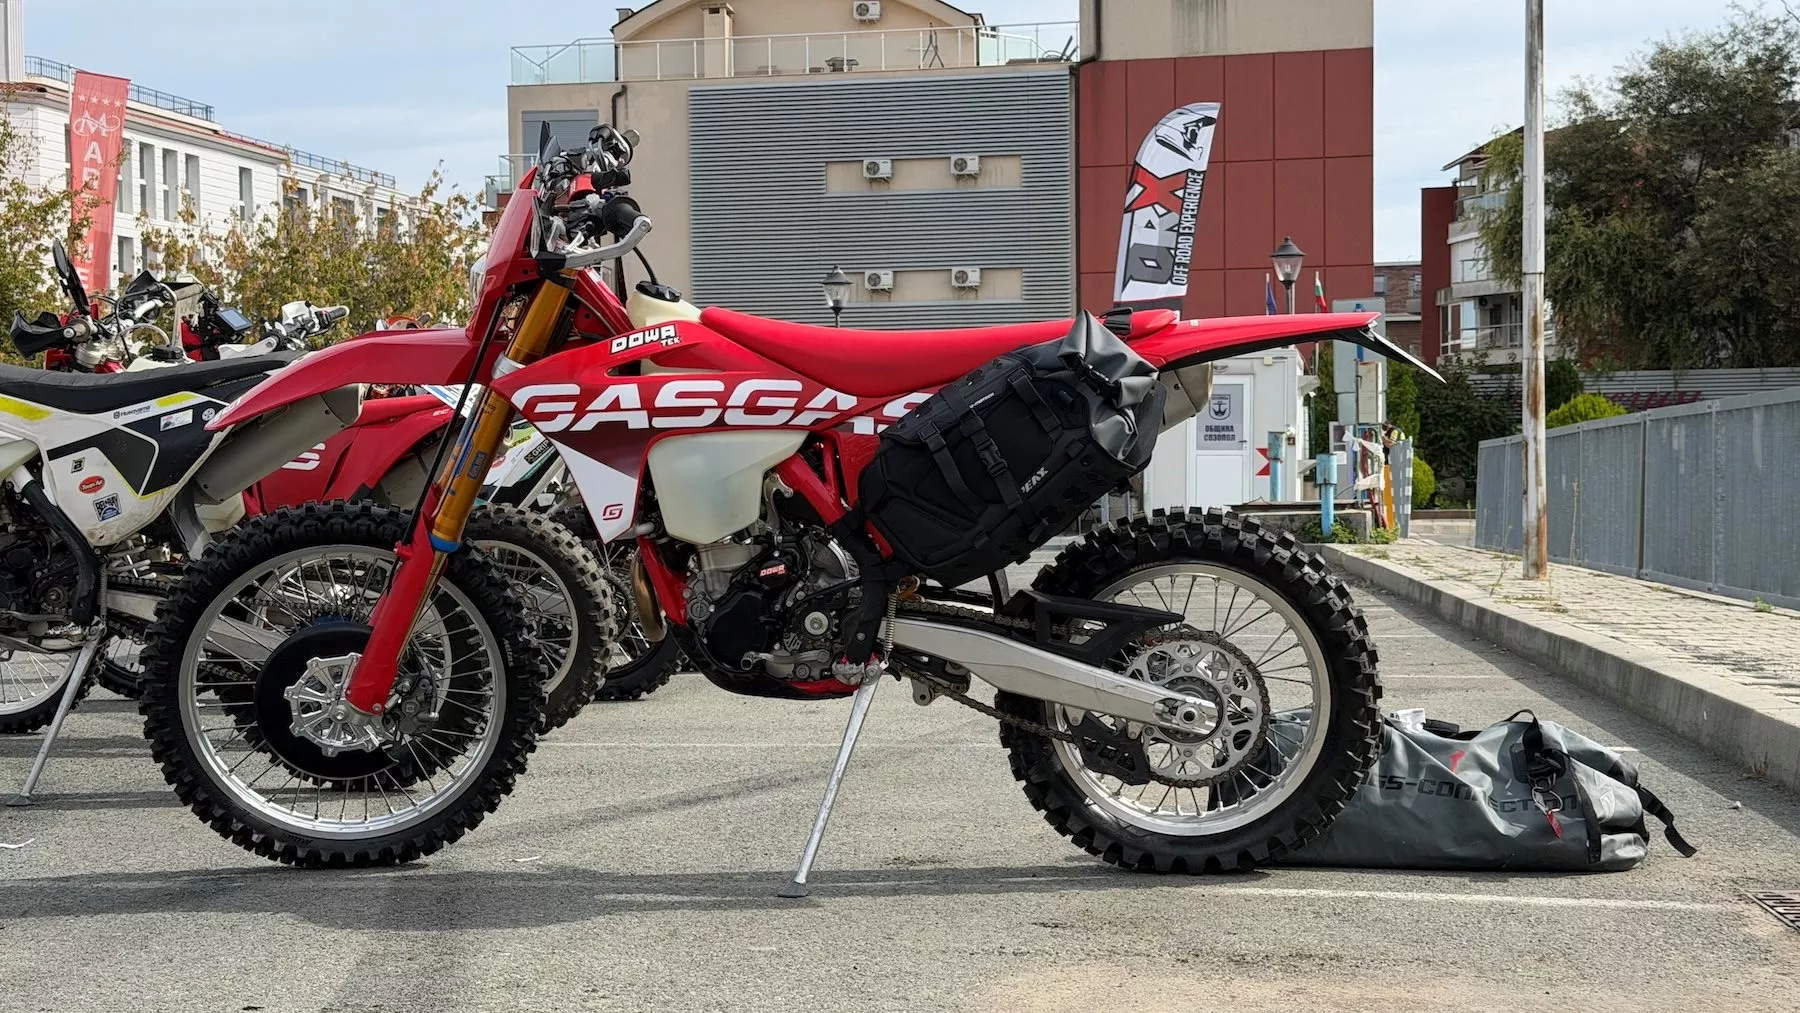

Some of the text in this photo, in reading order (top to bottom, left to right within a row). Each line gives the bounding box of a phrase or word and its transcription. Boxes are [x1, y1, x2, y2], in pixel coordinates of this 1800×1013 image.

[1172, 172, 1203, 284] OFF ROAD EXPERIENCE
[611, 324, 676, 353] DOWA
[661, 336, 680, 347] TEK
